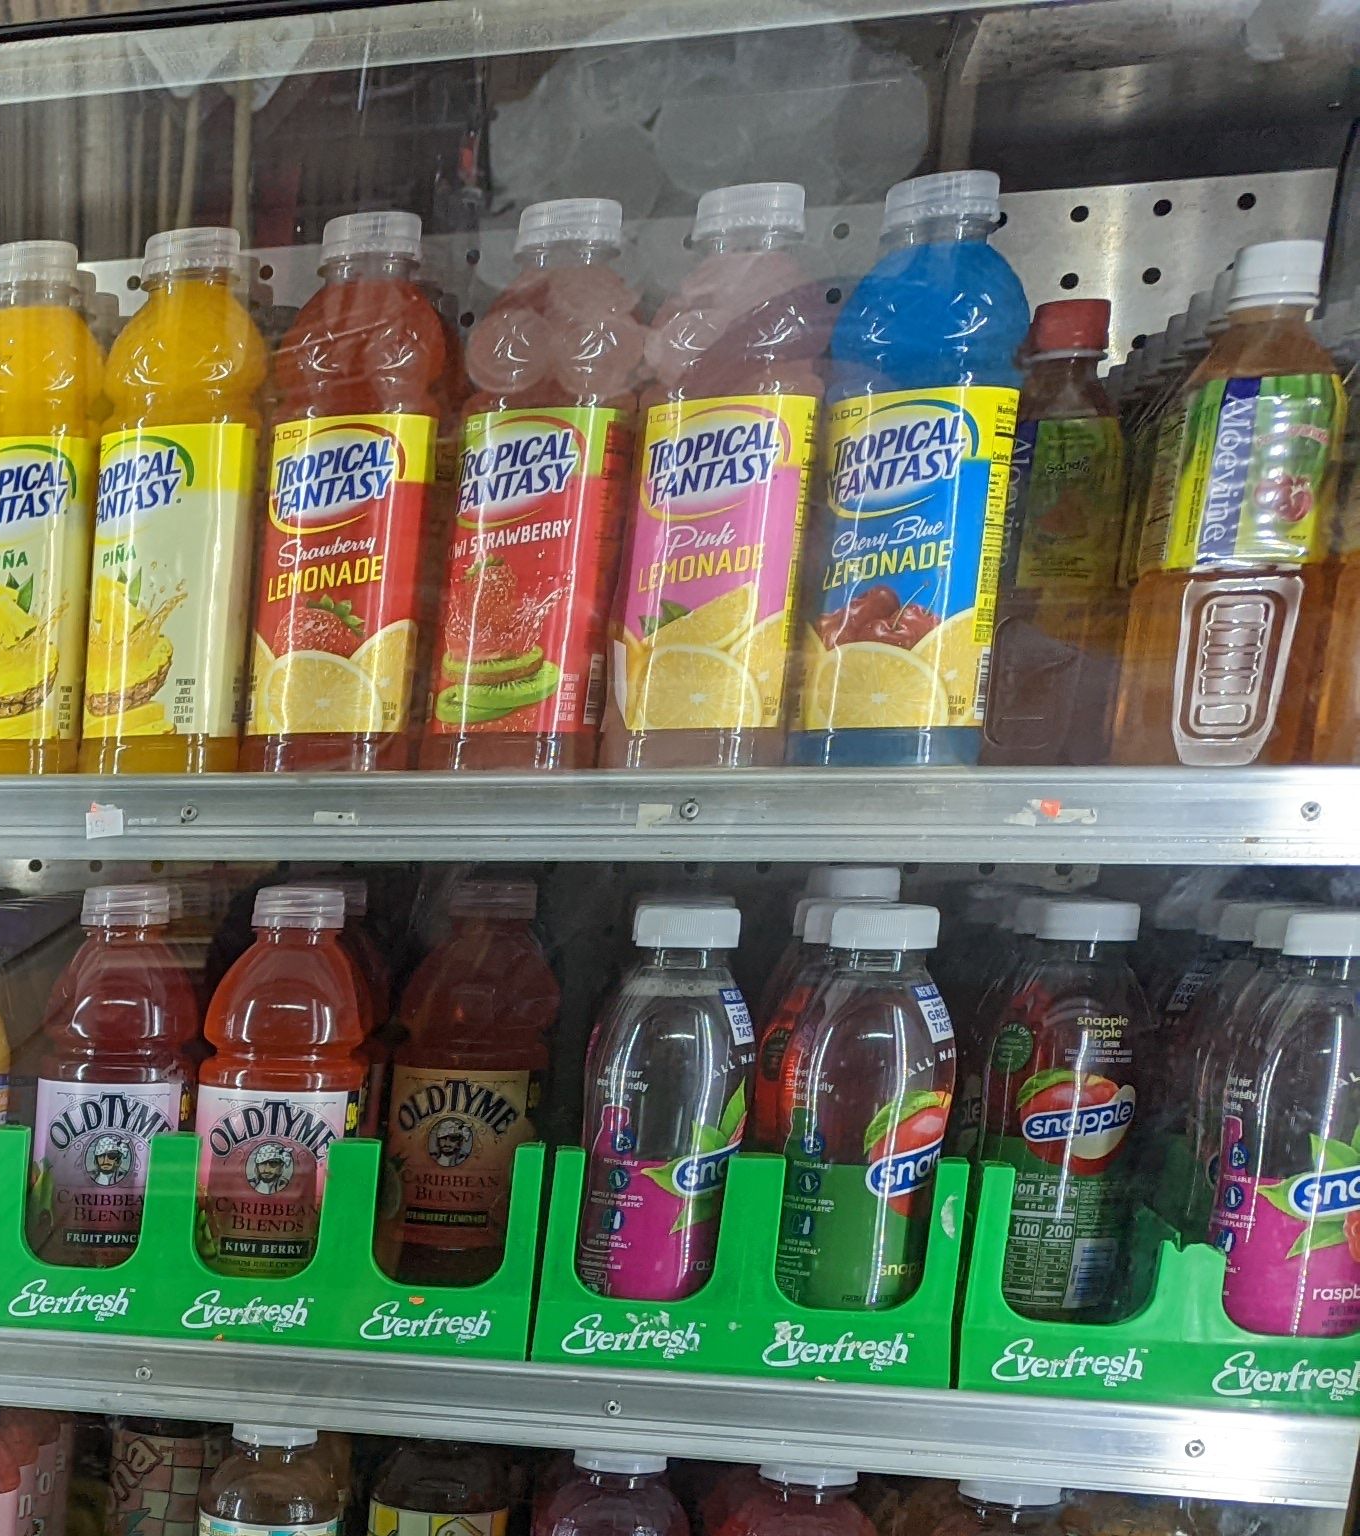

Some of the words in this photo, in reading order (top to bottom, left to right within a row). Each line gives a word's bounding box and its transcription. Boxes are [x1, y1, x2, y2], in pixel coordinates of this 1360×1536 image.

[275, 436, 394, 484] TROPICAL
[456, 428, 576, 489] TROPICAL
[647, 417, 780, 472] TROPICAL
[831, 412, 967, 468] TROPICAL
[274, 469, 393, 521] FANTASY
[455, 459, 576, 518] FANTASY
[648, 451, 778, 508] FANTASY
[831, 446, 964, 504] FANTASY
[101, 542, 137, 570] PIÑA
[278, 534, 377, 567] Strawberry
[469, 517, 574, 555] STRAWBERRY
[665, 524, 736, 556] Pink
[830, 530, 892, 560] Cherry
[894, 514, 946, 546] Blue
[267, 555, 385, 603] LEMONADE
[636, 543, 765, 594] LEMONADE
[821, 539, 953, 593] LEMONADE
[1077, 1015, 1129, 1028] snapple
[1087, 1026, 1123, 1039] apple
[1029, 1098, 1131, 1137] snapple
[214, 1198, 319, 1217] CARIBBEAN
[231, 1214, 305, 1234] BLENDS
[65, 1232, 100, 1245] FRUIT
[224, 1240, 260, 1254] KIWI
[264, 1243, 304, 1255] BERRY
[8, 1280, 130, 1318] Everfresh
[181, 1291, 309, 1330] Everfresh
[359, 1302, 492, 1341] Everfresh
[560, 1314, 702, 1356] Everfresh
[762, 1322, 910, 1368] Everfresh
[991, 1338, 1143, 1381] Everfresh
